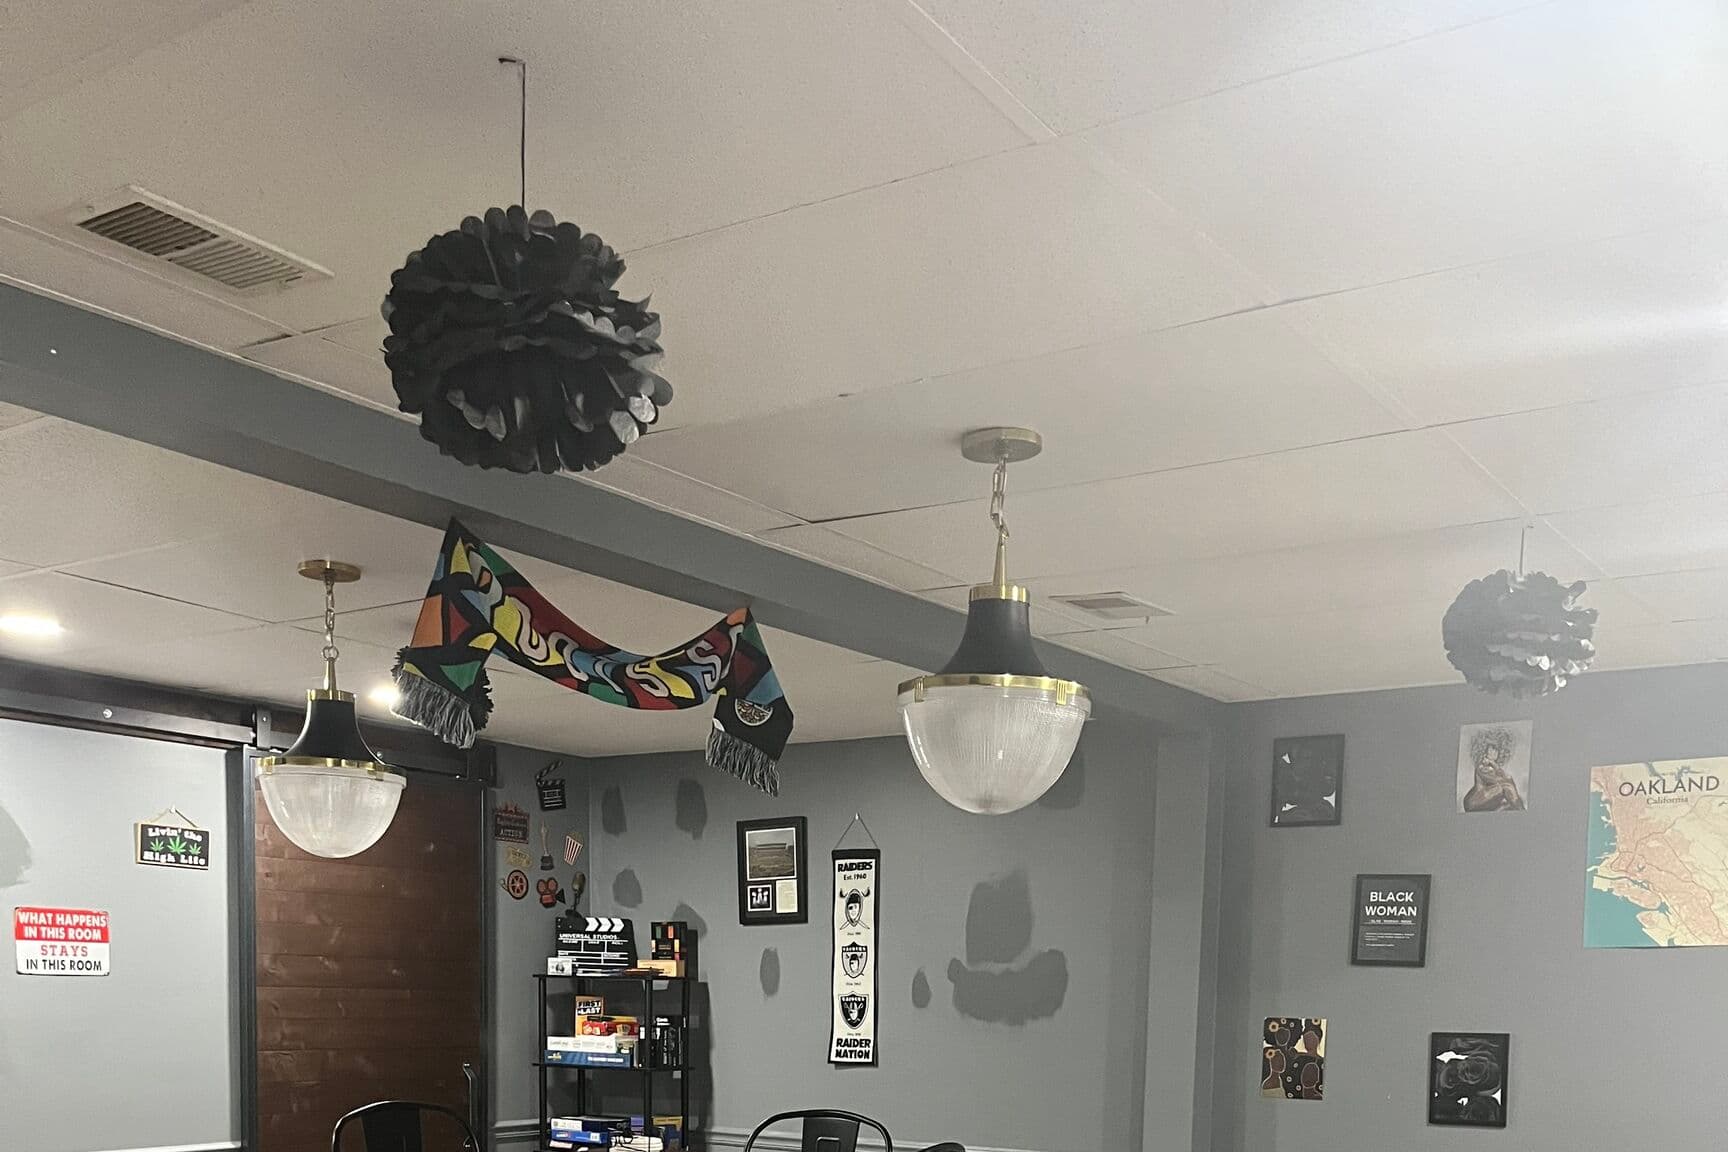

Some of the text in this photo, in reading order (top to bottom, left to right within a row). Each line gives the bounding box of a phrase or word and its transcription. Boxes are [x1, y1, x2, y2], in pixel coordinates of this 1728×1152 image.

[1618, 775, 1720, 797] OAKLAND
[1646, 796, 1689, 805] California
[147, 827, 203, 842] Livin' the
[143, 851, 206, 866] High Life
[837, 861, 873, 872] RAIDERS
[853, 873, 867, 881] 1960
[1369, 891, 1415, 902] BLACK
[1364, 905, 1418, 916] WOMAN
[18, 911, 107, 927] WHAT HAPPENS
[24, 927, 102, 941] IN THIS ROOM
[40, 944, 89, 957] STAYS
[26, 958, 102, 971] IN THIS ROOM
[836, 1038, 872, 1048] RAIDER
[835, 1049, 870, 1059] NATION
